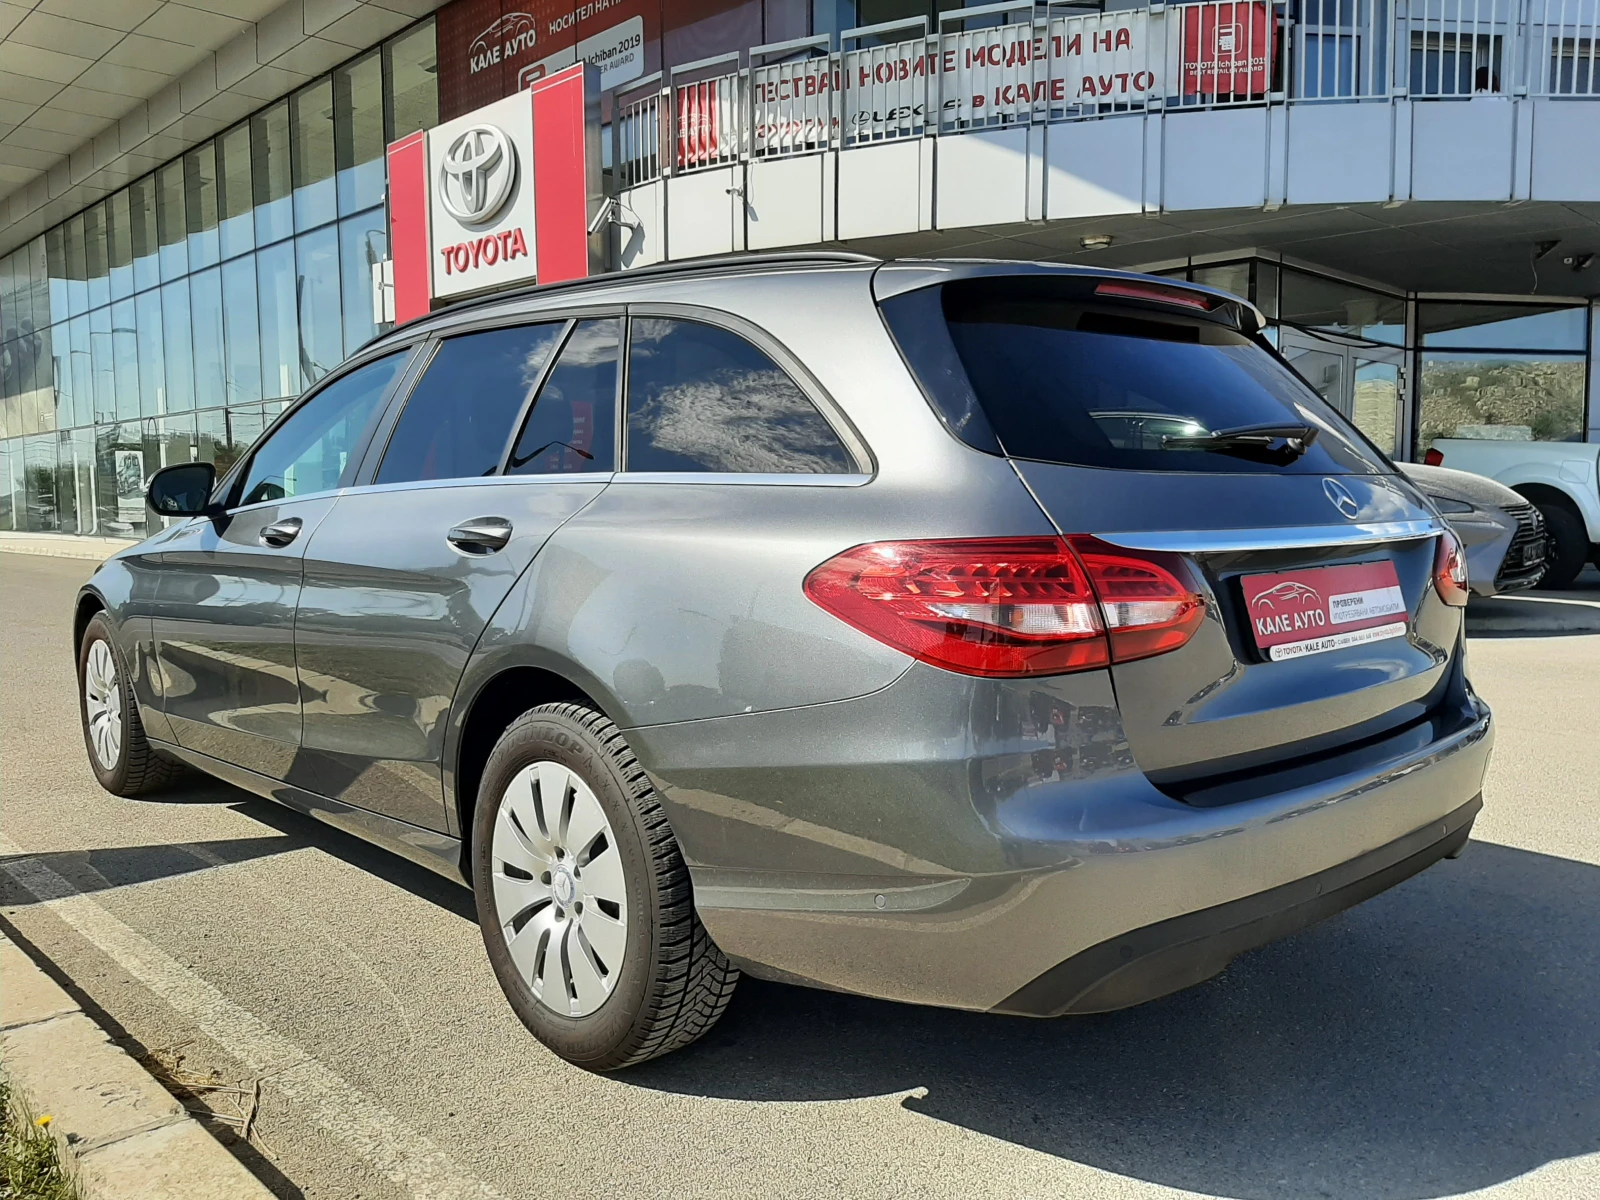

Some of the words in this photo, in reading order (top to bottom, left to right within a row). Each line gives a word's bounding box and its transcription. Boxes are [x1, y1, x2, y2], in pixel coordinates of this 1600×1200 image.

[549, 4, 594, 35] НОСИТЕЛ
[504, 29, 536, 60] АУТО
[618, 34, 641, 54] 2019
[859, 50, 956, 87] НОВИТЕ
[1093, 28, 1134, 53] НА
[609, 53, 635, 71] AWARD
[994, 78, 1065, 106] КАЛЕ
[1077, 71, 1155, 98] АУТО
[441, 227, 528, 276] TOYOTA
[1255, 613, 1293, 636] КАЛЕ
[1294, 608, 1325, 630] АУТО
[1282, 645, 1303, 655] TOYOTA
